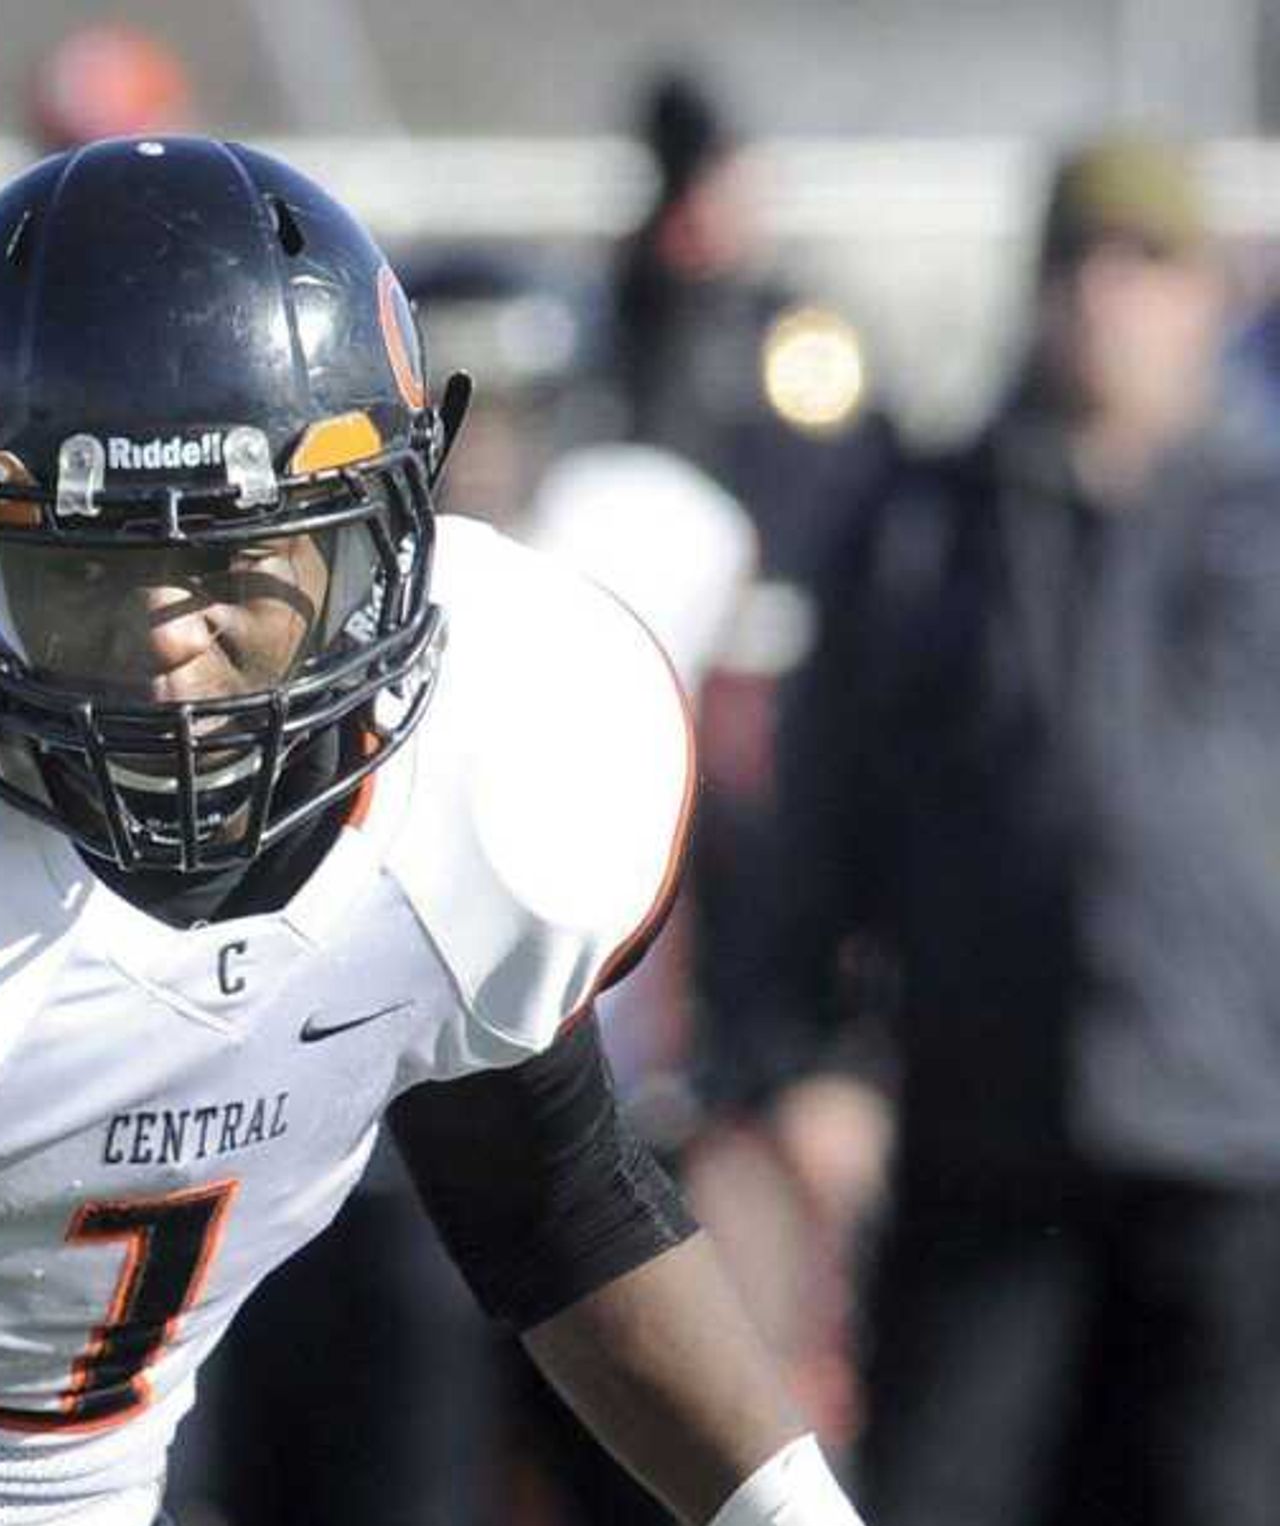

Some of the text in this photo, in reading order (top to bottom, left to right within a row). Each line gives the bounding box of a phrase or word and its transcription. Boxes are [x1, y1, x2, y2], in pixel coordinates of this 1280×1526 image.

[107, 431, 223, 470] Riddell
[216, 940, 248, 996] C
[102, 1092, 289, 1166] CENTRAL
